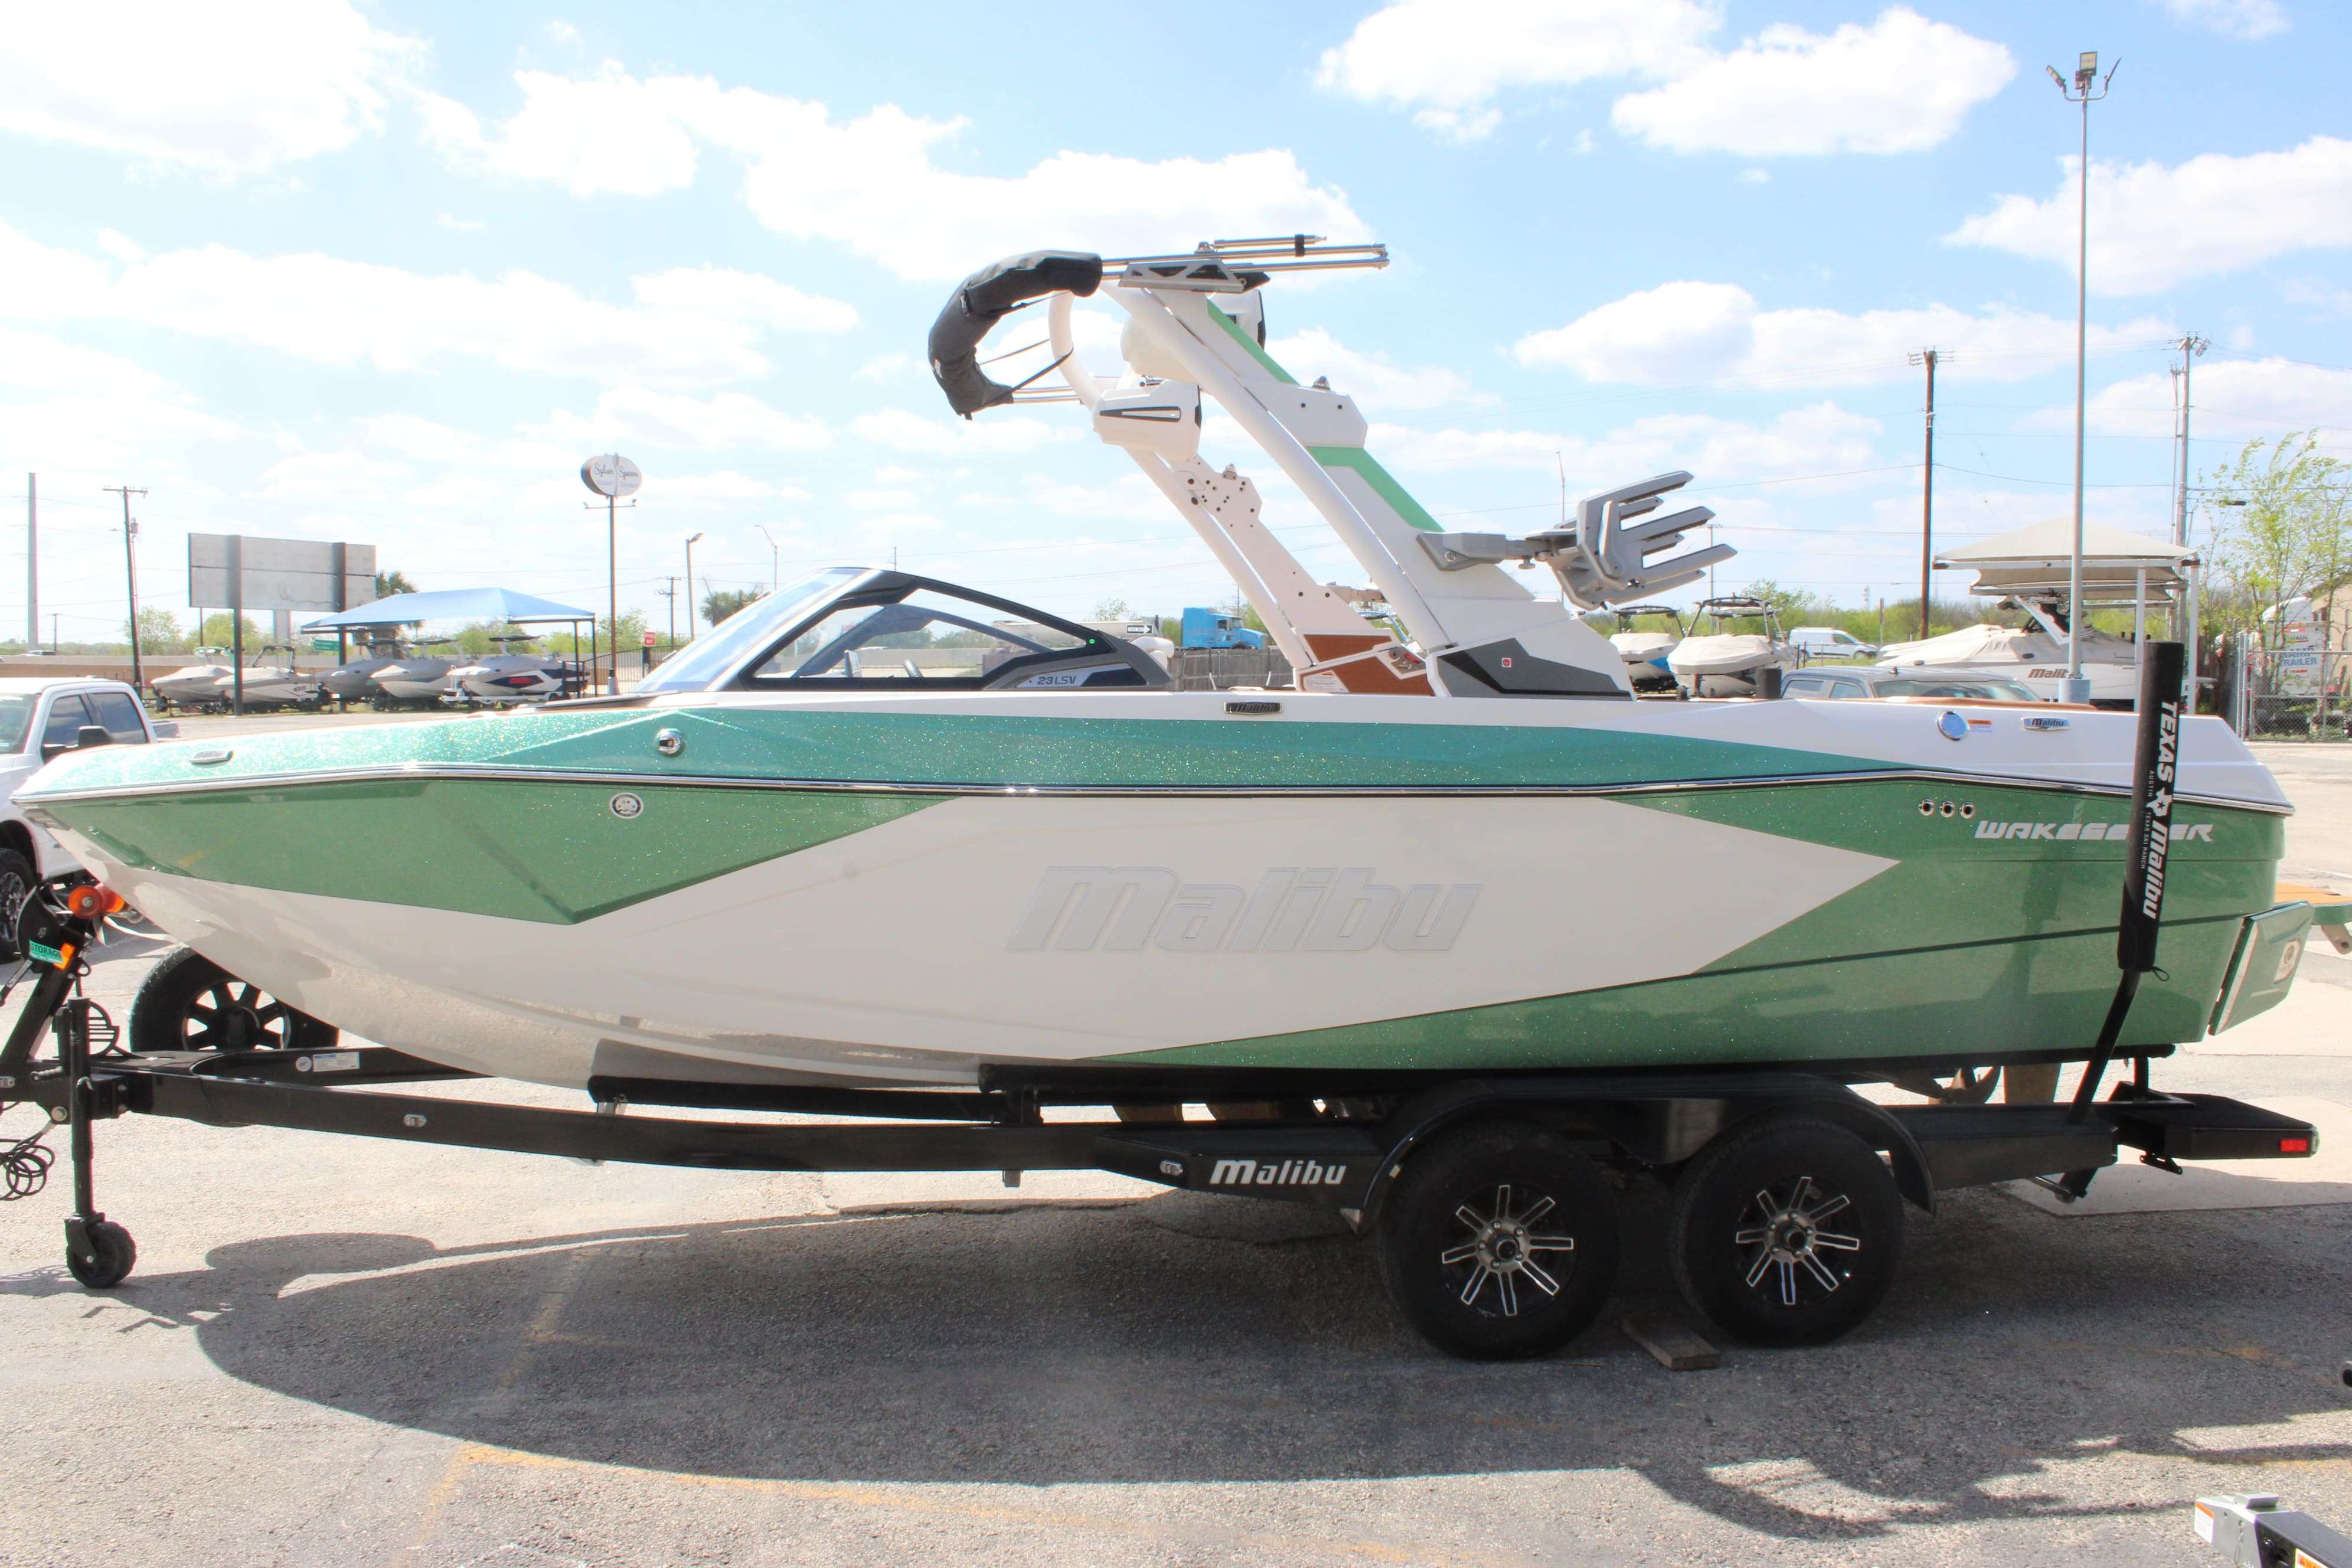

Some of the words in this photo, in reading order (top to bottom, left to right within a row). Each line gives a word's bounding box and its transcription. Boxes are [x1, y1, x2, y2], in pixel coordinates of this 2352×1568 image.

[2284, 657, 2317, 666] RAILER
[2031, 718, 2064, 727] Malibu
[2157, 701, 2178, 783] TEXAS
[1974, 821, 2214, 842] WAKESEER
[2140, 847, 2148, 869] RANCH
[2143, 820, 2169, 920] Malibu
[1006, 866, 1485, 953] Malibu
[31, 944, 62, 959] STORAGE
[1209, 1159, 1347, 1185] Malibu
